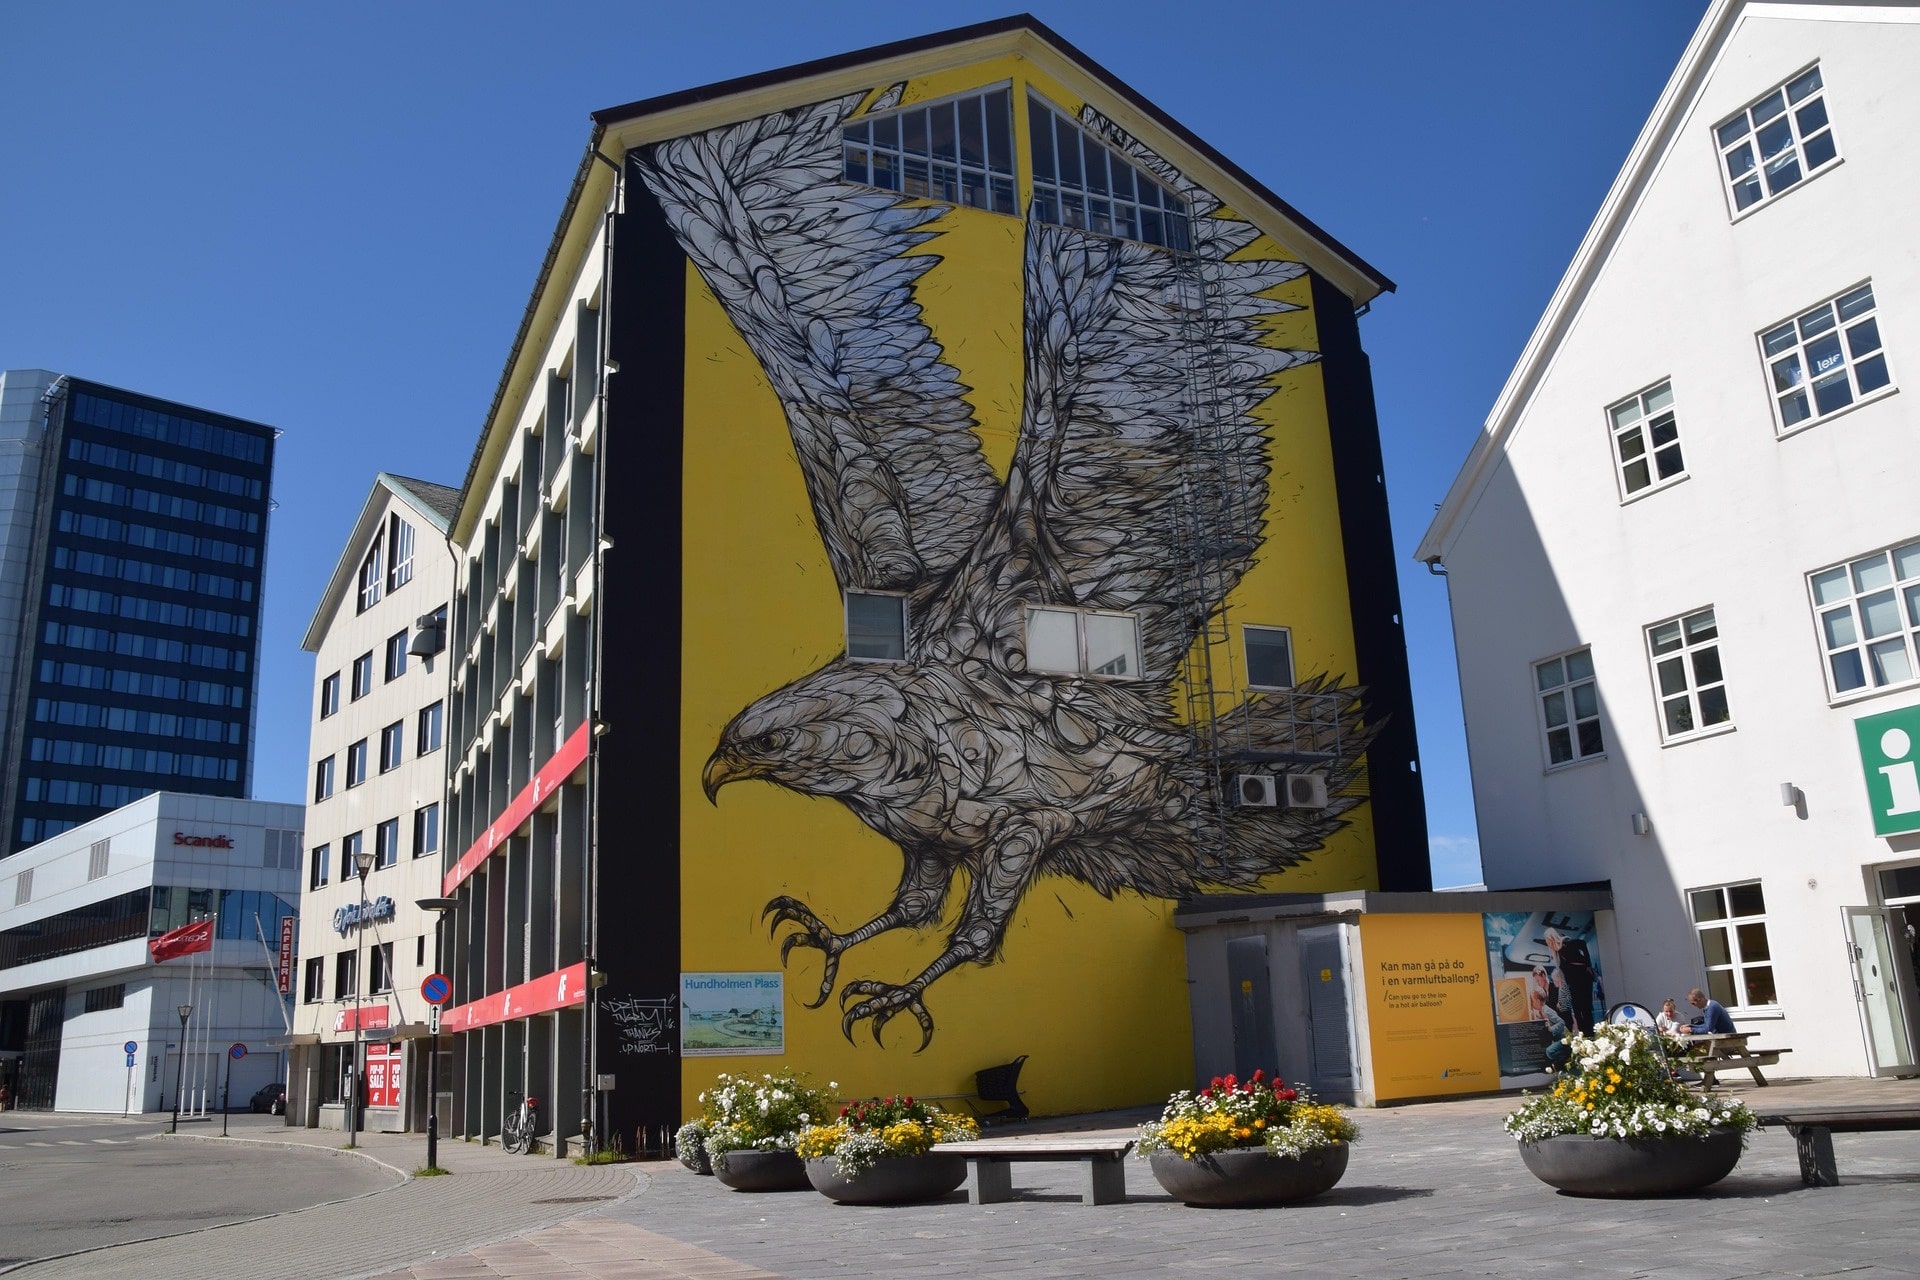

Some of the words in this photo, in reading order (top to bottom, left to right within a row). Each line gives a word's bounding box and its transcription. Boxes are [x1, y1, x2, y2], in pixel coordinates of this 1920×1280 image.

[174, 832, 235, 849] Scandic
[280, 919, 292, 992] KAFETERIA
[1381, 962, 1399, 971] Kan
[1402, 962, 1422, 971] man
[1424, 959, 1436, 972] gå
[1438, 959, 1450, 971] på
[1452, 960, 1465, 969] do
[685, 979, 752, 989] Hundholmen
[754, 978, 779, 989] Plass
[1382, 976, 1385, 986] i
[1388, 978, 1400, 986] en
[1402, 973, 1480, 985] varmluftballong?
[1389, 993, 1400, 1001] Can
[1420, 1000, 1443, 1008] balloon?
[623, 1027, 661, 1041] THANKS
[369, 1074, 385, 1089] SALG
